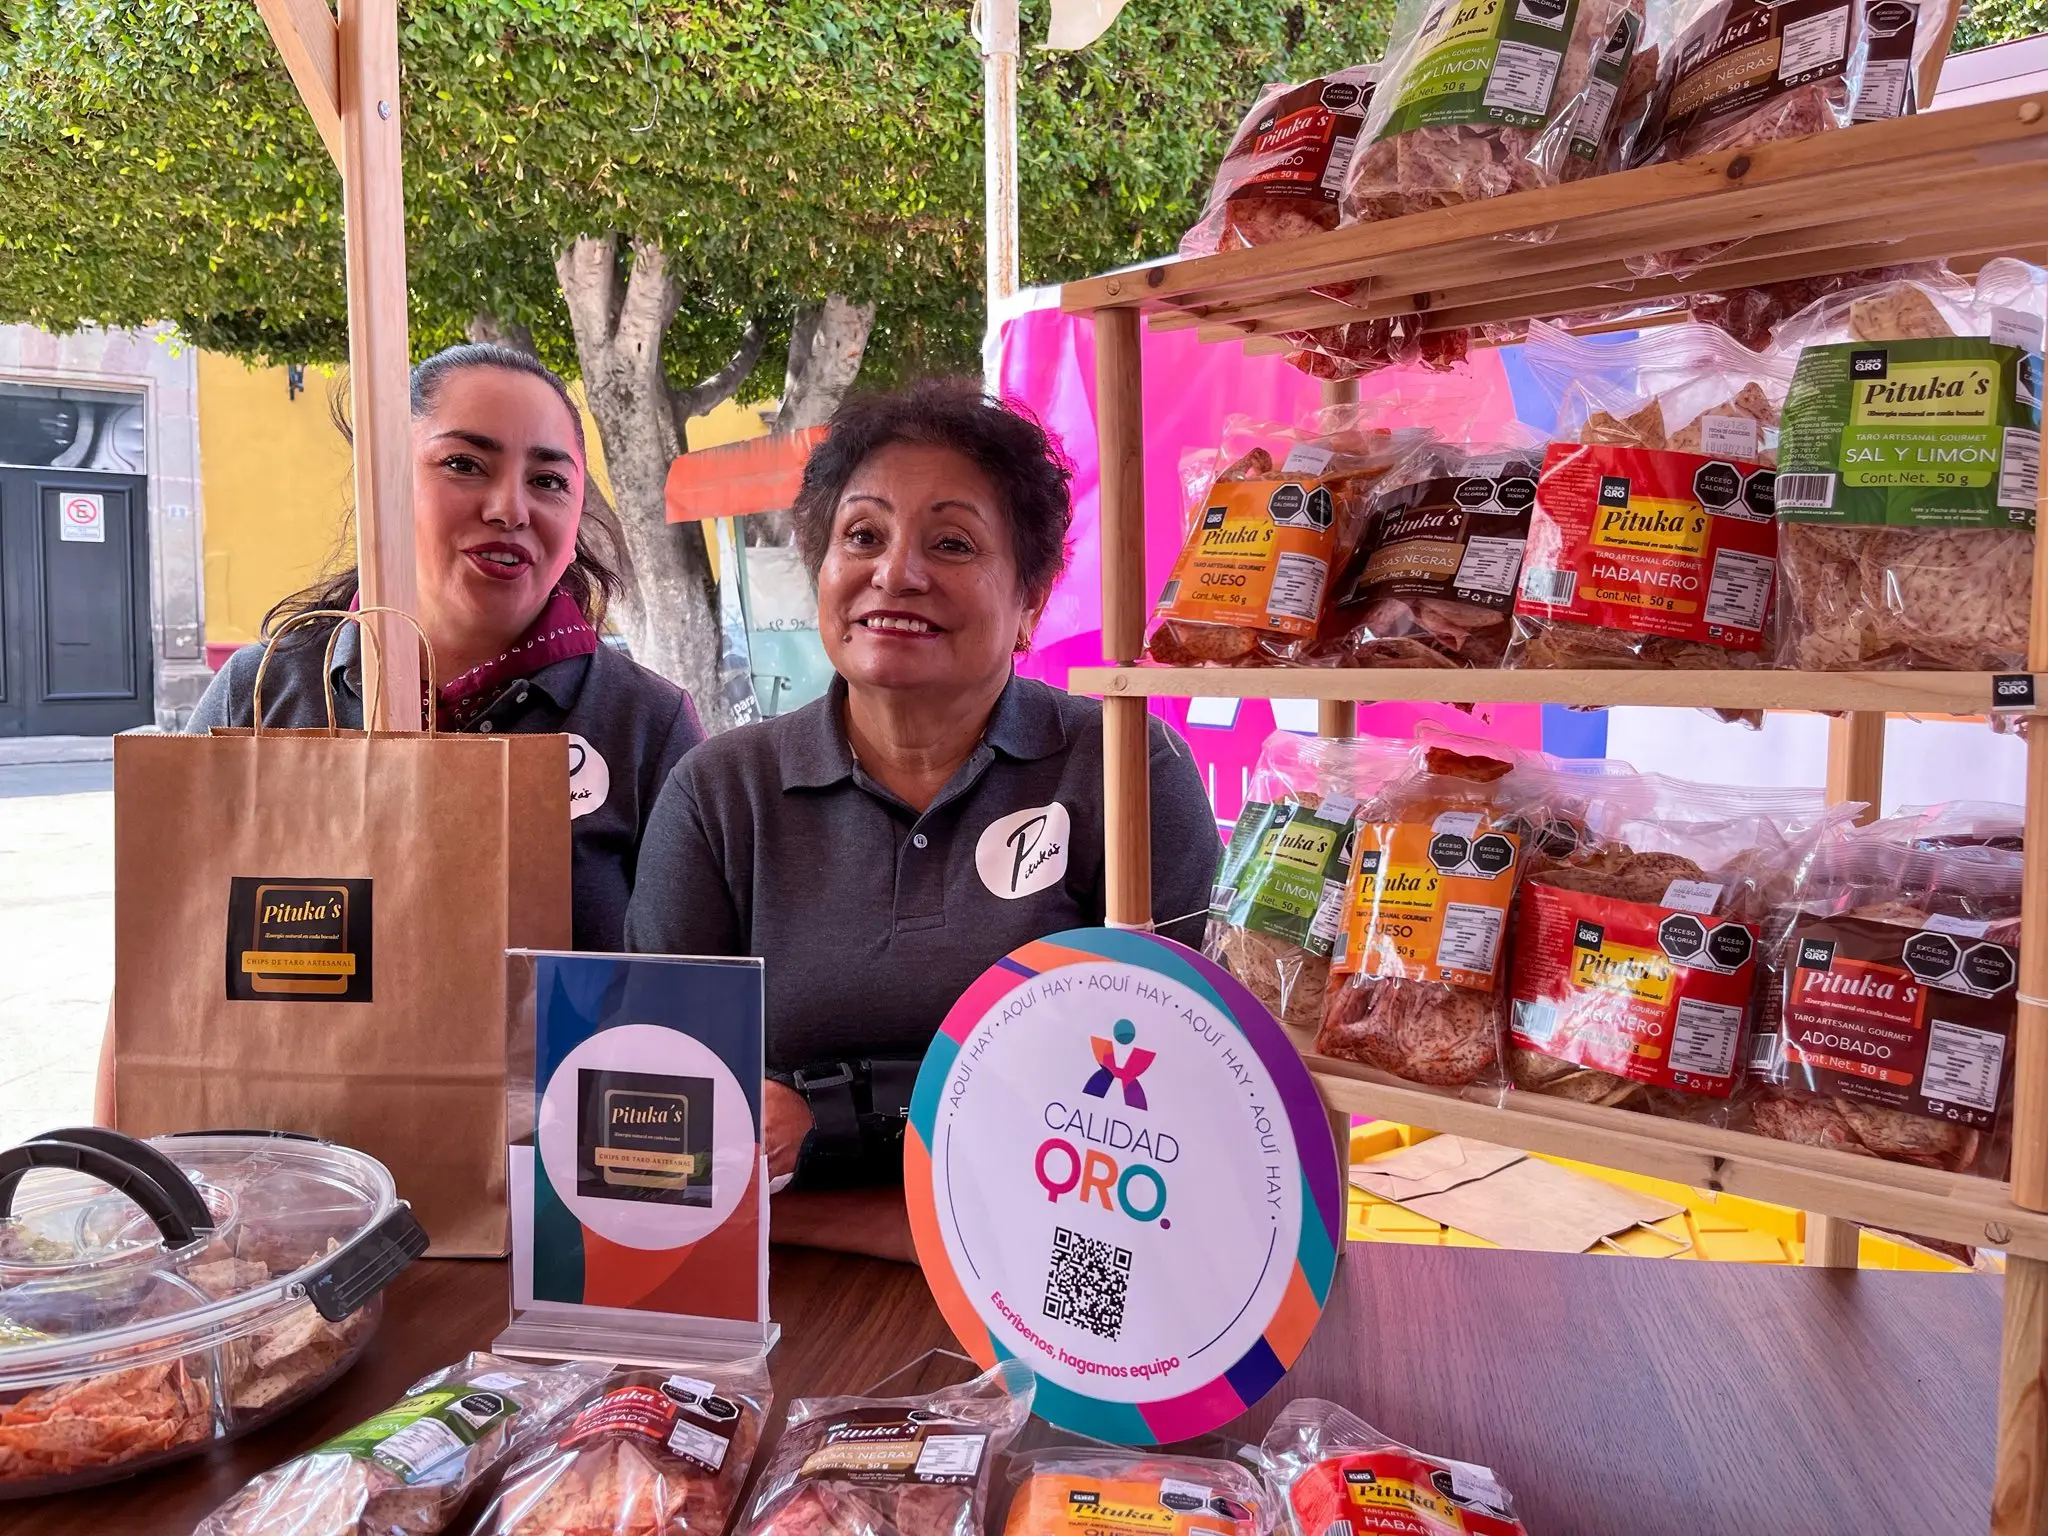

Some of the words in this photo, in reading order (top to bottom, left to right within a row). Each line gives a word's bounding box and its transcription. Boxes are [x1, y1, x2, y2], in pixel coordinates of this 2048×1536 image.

[1715, 55, 1774, 83] NEGRAS
[1441, 81, 1456, 92] 50
[1727, 82, 1741, 93] 50
[1280, 170, 1292, 179] 50
[1855, 362, 1882, 372] QRO
[1856, 433, 1880, 441] TARO
[1882, 433, 1935, 441] ARTESANAL
[1939, 433, 1988, 441] GOURMET
[1845, 448, 1885, 463] SAL
[1894, 447, 1909, 461] Y
[1917, 445, 1996, 463] LIMÓN
[1704, 475, 1733, 485] EXCESO
[1937, 473, 1955, 483] 50
[1960, 475, 1968, 486] g
[1603, 489, 1626, 499] QRO
[1402, 554, 1455, 567] NEGRAS
[1595, 550, 1616, 559] TARO
[1615, 553, 1660, 565] ARTESANAL
[1662, 558, 1702, 570] GOURMET
[1200, 572, 1246, 587] QUESO
[1409, 569, 1422, 577] 50
[1591, 563, 1698, 590] HABANERO
[1229, 594, 1240, 603] 50
[1240, 597, 1247, 605] g
[1649, 595, 1664, 606] 50
[1666, 600, 1674, 610] g
[1997, 685, 2028, 695] QRO
[1479, 846, 1505, 854] EXCESO
[1281, 900, 1293, 911] 50
[1401, 913, 1433, 923] GOURMET
[1578, 932, 1600, 943] QRO
[1668, 926, 1696, 937] EXCESO
[1717, 936, 1745, 946] EXCESO
[1397, 945, 1408, 955] 50
[1409, 949, 1415, 958] g
[1720, 945, 1741, 953] SODIO
[1916, 944, 1949, 956] EXCESO
[1804, 951, 1828, 961] QRO
[1972, 956, 2005, 968] EXCESO
[306, 959, 352, 967] ARTESANAL
[1975, 966, 2000, 976] SODIO
[1041, 976, 1074, 999] HAY
[1088, 974, 1130, 992] AQUÍ
[1136, 981, 1173, 1007] HAY
[1001, 989, 1038, 1025] AQUÍ
[1630, 1004, 1667, 1018] GOURMET
[1831, 1001, 1857, 1012] natural
[1866, 1008, 1883, 1017] cada
[1181, 1008, 1226, 1048] AQUÍ
[1793, 1013, 1815, 1023] TARO
[1816, 1017, 1866, 1033] ARTESANAL
[1868, 1027, 1913, 1043] GOURMET
[970, 1026, 995, 1062] HAY
[1632, 1044, 1640, 1054] g
[1800, 1030, 1891, 1059] ADOBADO
[1221, 1047, 1254, 1088] HAY
[1860, 1063, 1876, 1075] 50
[1879, 1070, 1888, 1081] g
[949, 1061, 974, 1109] AQUÍ
[1044, 1102, 1180, 1164] CALIDAD
[1250, 1103, 1281, 1156] AQUÍ
[598, 1153, 620, 1161] CHIPS
[632, 1156, 651, 1164] TARO
[651, 1157, 692, 1168] ARTESANAL
[1265, 1165, 1283, 1210] HAY
[990, 1290, 1057, 1360] Escríbenos,
[1058, 1347, 1128, 1378] hagamos
[1130, 1356, 1180, 1381] equipo
[857, 1450, 914, 1459] NEGRAS
